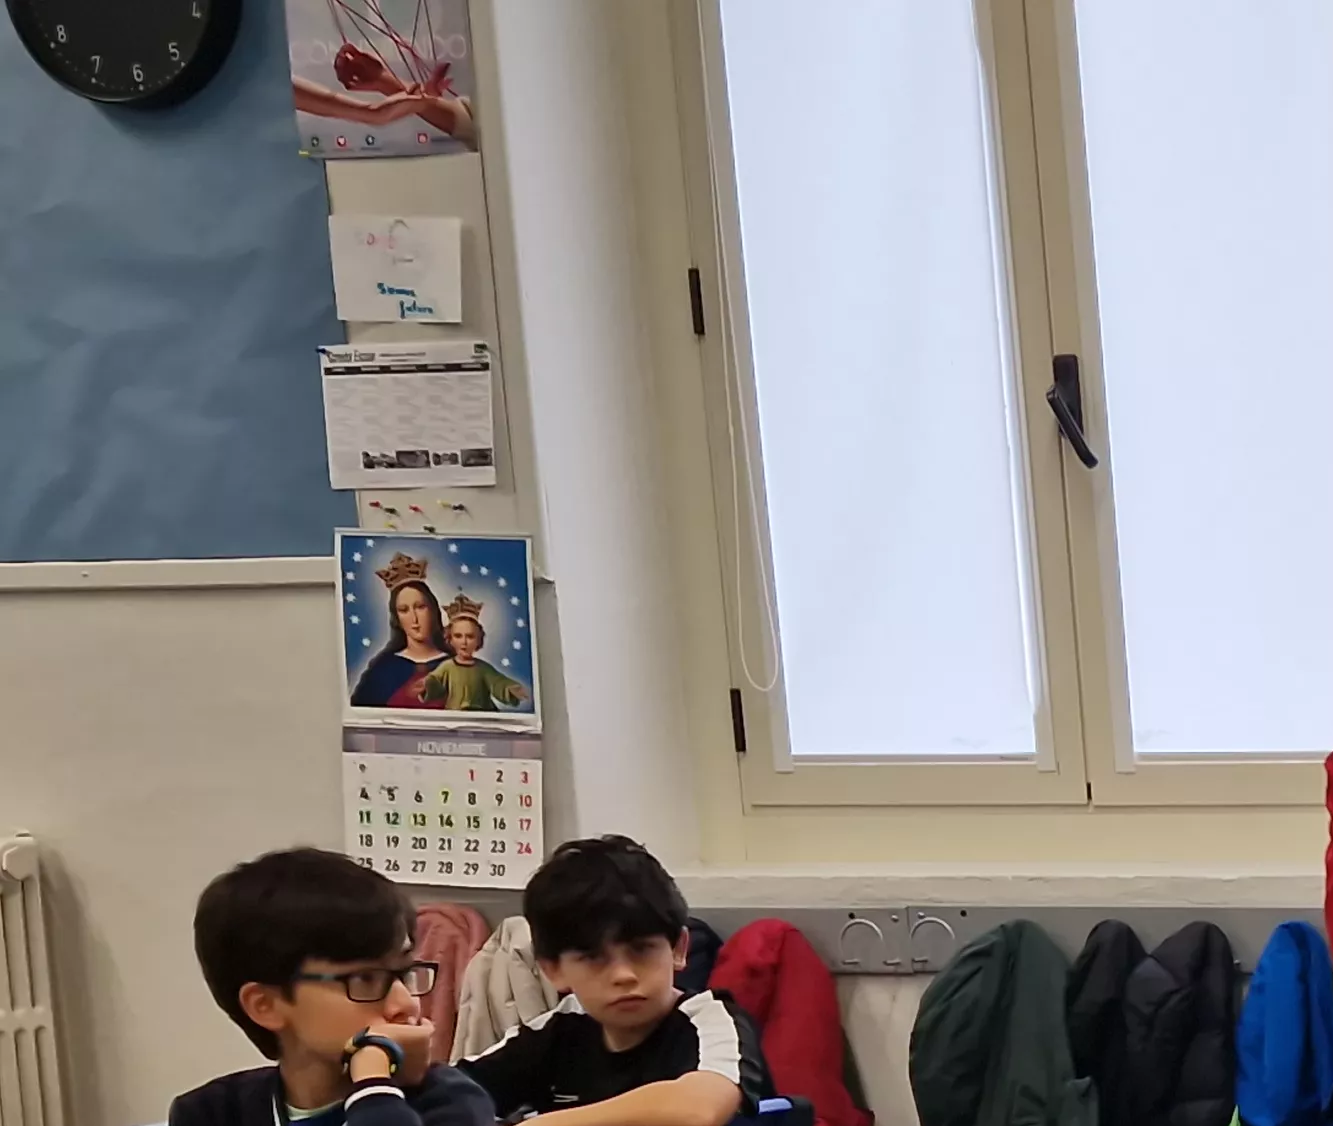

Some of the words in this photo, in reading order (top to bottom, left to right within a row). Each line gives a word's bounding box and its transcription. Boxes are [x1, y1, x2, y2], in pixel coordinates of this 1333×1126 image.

[56, 24, 67, 43] 8
[168, 42, 180, 61] 5
[90, 55, 101, 74] 7
[132, 64, 144, 82] 6
[416, 741, 488, 757] NOVIEMBRE
[469, 769, 475, 782] 1
[496, 770, 504, 783] 2
[521, 771, 529, 784] 3
[359, 787, 370, 801] 4
[387, 788, 396, 801] 5
[414, 790, 423, 803] 6
[441, 791, 449, 804] 7
[468, 792, 477, 805] 8
[495, 793, 504, 806] 9
[519, 794, 533, 808] 10
[358, 810, 371, 824] 11
[385, 812, 400, 826] 12
[412, 813, 426, 827] 13
[439, 814, 454, 828] 14
[466, 815, 481, 829] 15
[493, 817, 506, 830] 16
[519, 818, 532, 831] 17
[358, 834, 373, 847] 18
[386, 835, 400, 848] 19
[411, 836, 427, 850] 20
[438, 838, 452, 851] 21
[464, 839, 479, 852] 22
[491, 840, 506, 854] 23
[517, 841, 532, 855] 24
[385, 859, 400, 872] 26
[411, 860, 426, 874] 27
[438, 861, 453, 875] 28
[463, 862, 479, 876] 29
[489, 864, 506, 877] 30
